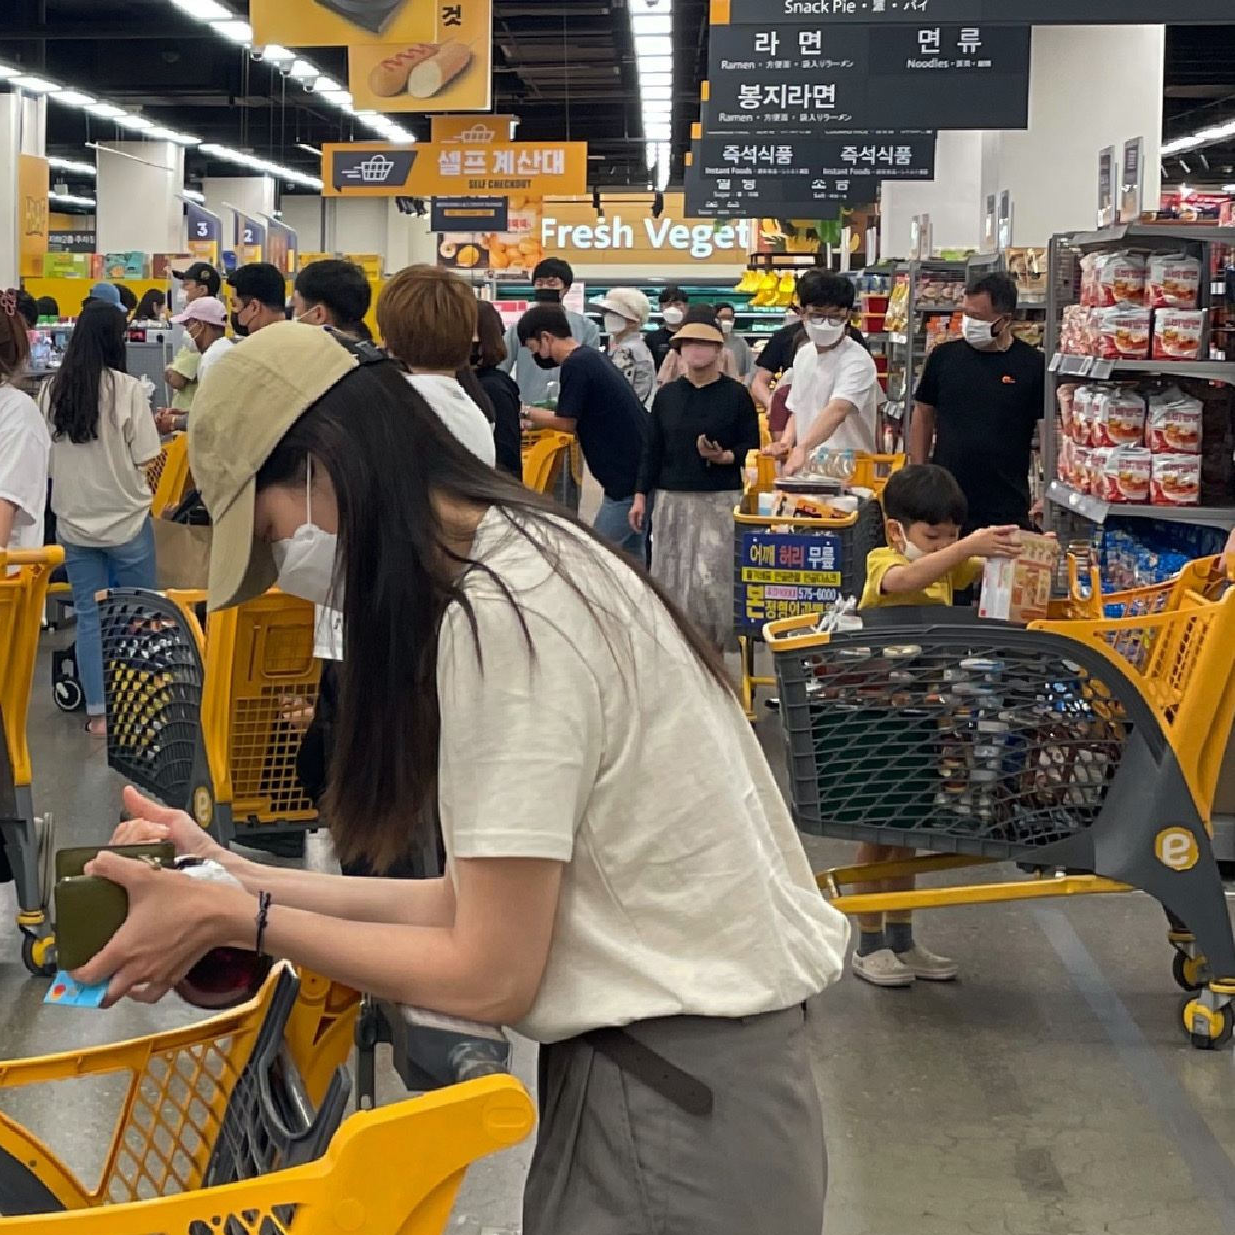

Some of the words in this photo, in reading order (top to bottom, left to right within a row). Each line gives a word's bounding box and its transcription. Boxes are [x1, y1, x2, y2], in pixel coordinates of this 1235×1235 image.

[785, 0, 829, 14] Snack
[833, 0, 856, 14] Pie
[754, 31, 780, 56] 라
[799, 30, 822, 55] 면
[917, 28, 940, 54] 면
[957, 28, 982, 54] 류
[721, 60, 755, 70] Ramen
[907, 58, 948, 69] Noodles
[738, 84, 836, 109] 봉지라면
[719, 112, 753, 122] Ramen
[438, 149, 487, 176] 셀프
[492, 149, 565, 175] 계산대
[722, 145, 793, 165] 즉석식품
[840, 145, 912, 165] 즉석식품
[468, 179, 486, 189] SELF
[488, 179, 532, 189] CHECKOUT
[196, 222, 208, 237] 3
[244, 229, 252, 242] 2
[542, 216, 634, 249] Fresh
[644, 217, 749, 257] Veget
[749, 543, 776, 566] 어깨
[779, 545, 805, 568] 허리
[807, 546, 835, 570] 무릎
